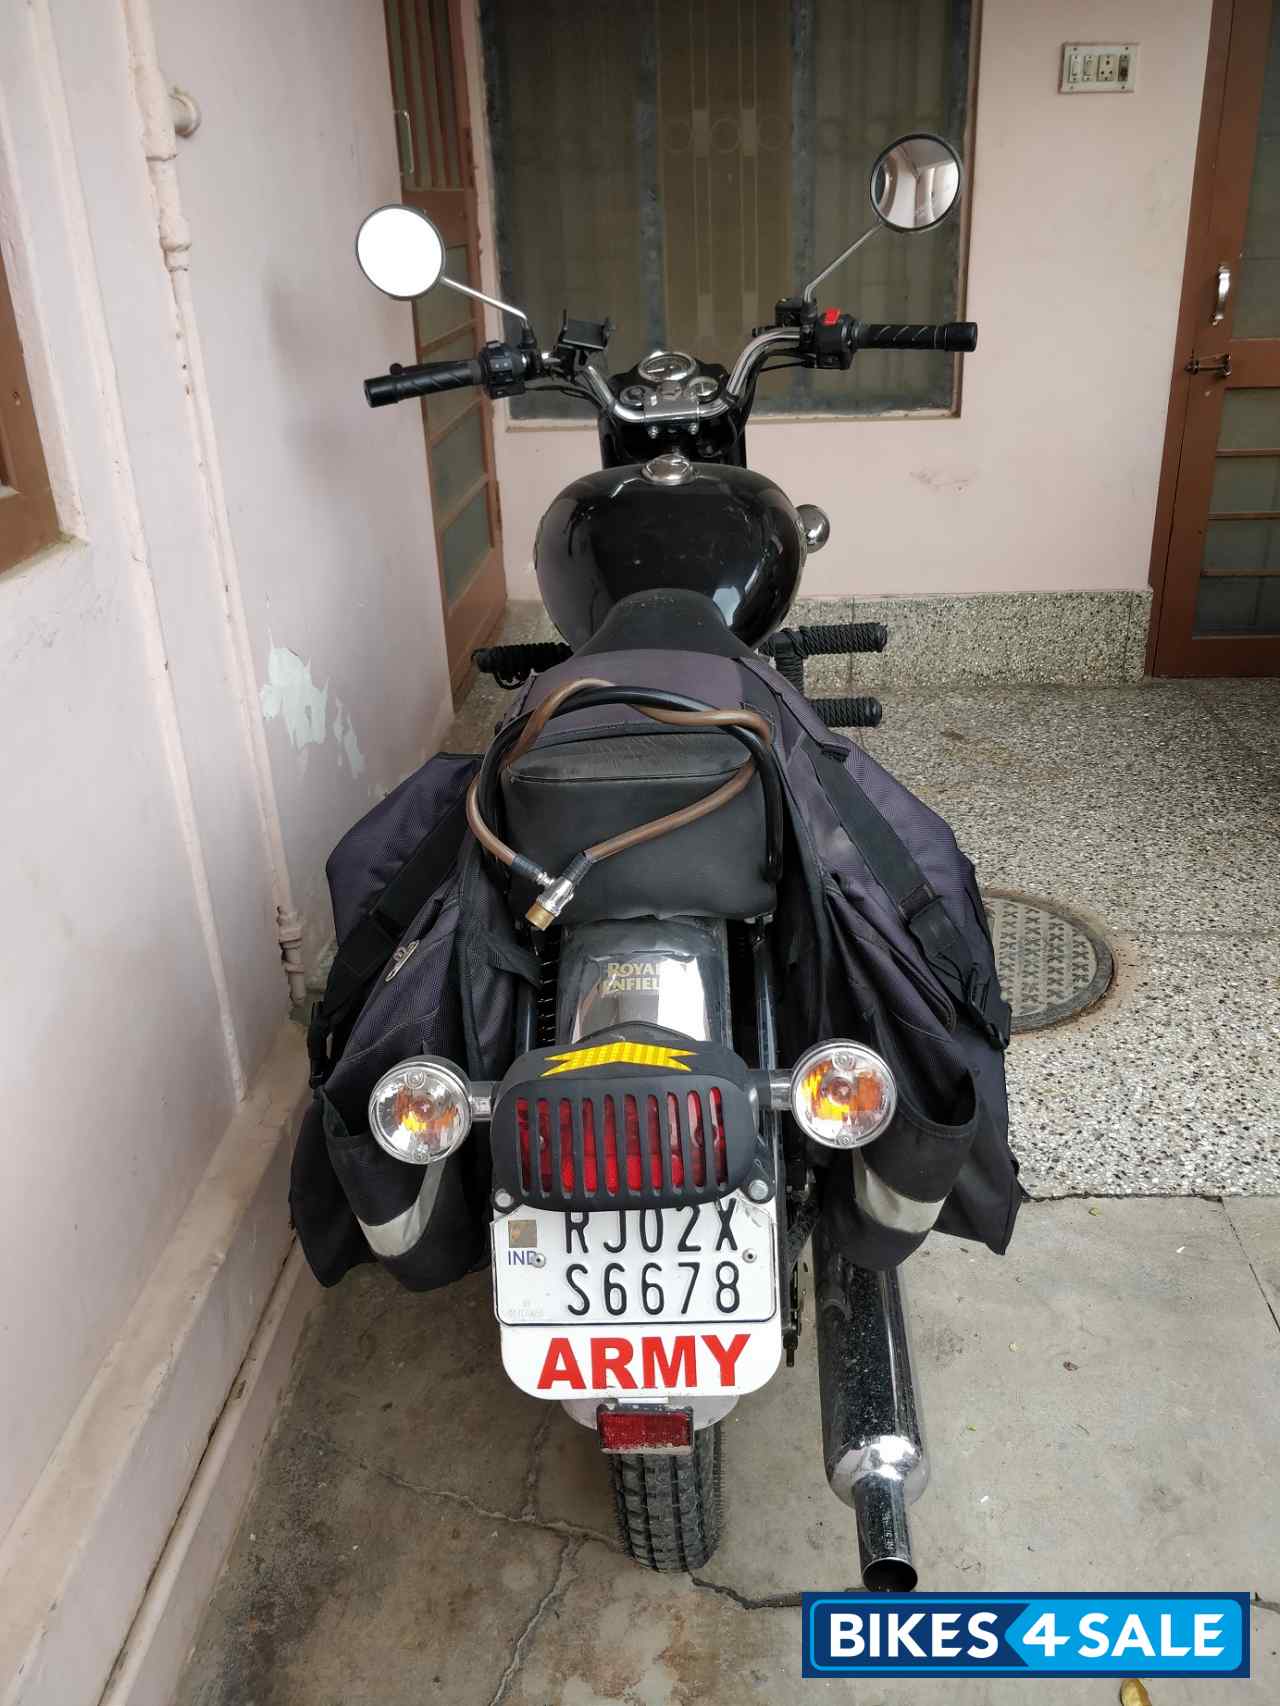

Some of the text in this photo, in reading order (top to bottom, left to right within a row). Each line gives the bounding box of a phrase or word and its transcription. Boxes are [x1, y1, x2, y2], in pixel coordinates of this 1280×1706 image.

[565, 1198, 738, 1254] RJ02X
[507, 1250, 538, 1266] IND
[566, 1261, 741, 1316] S6678
[537, 1334, 751, 1390] ARMY
